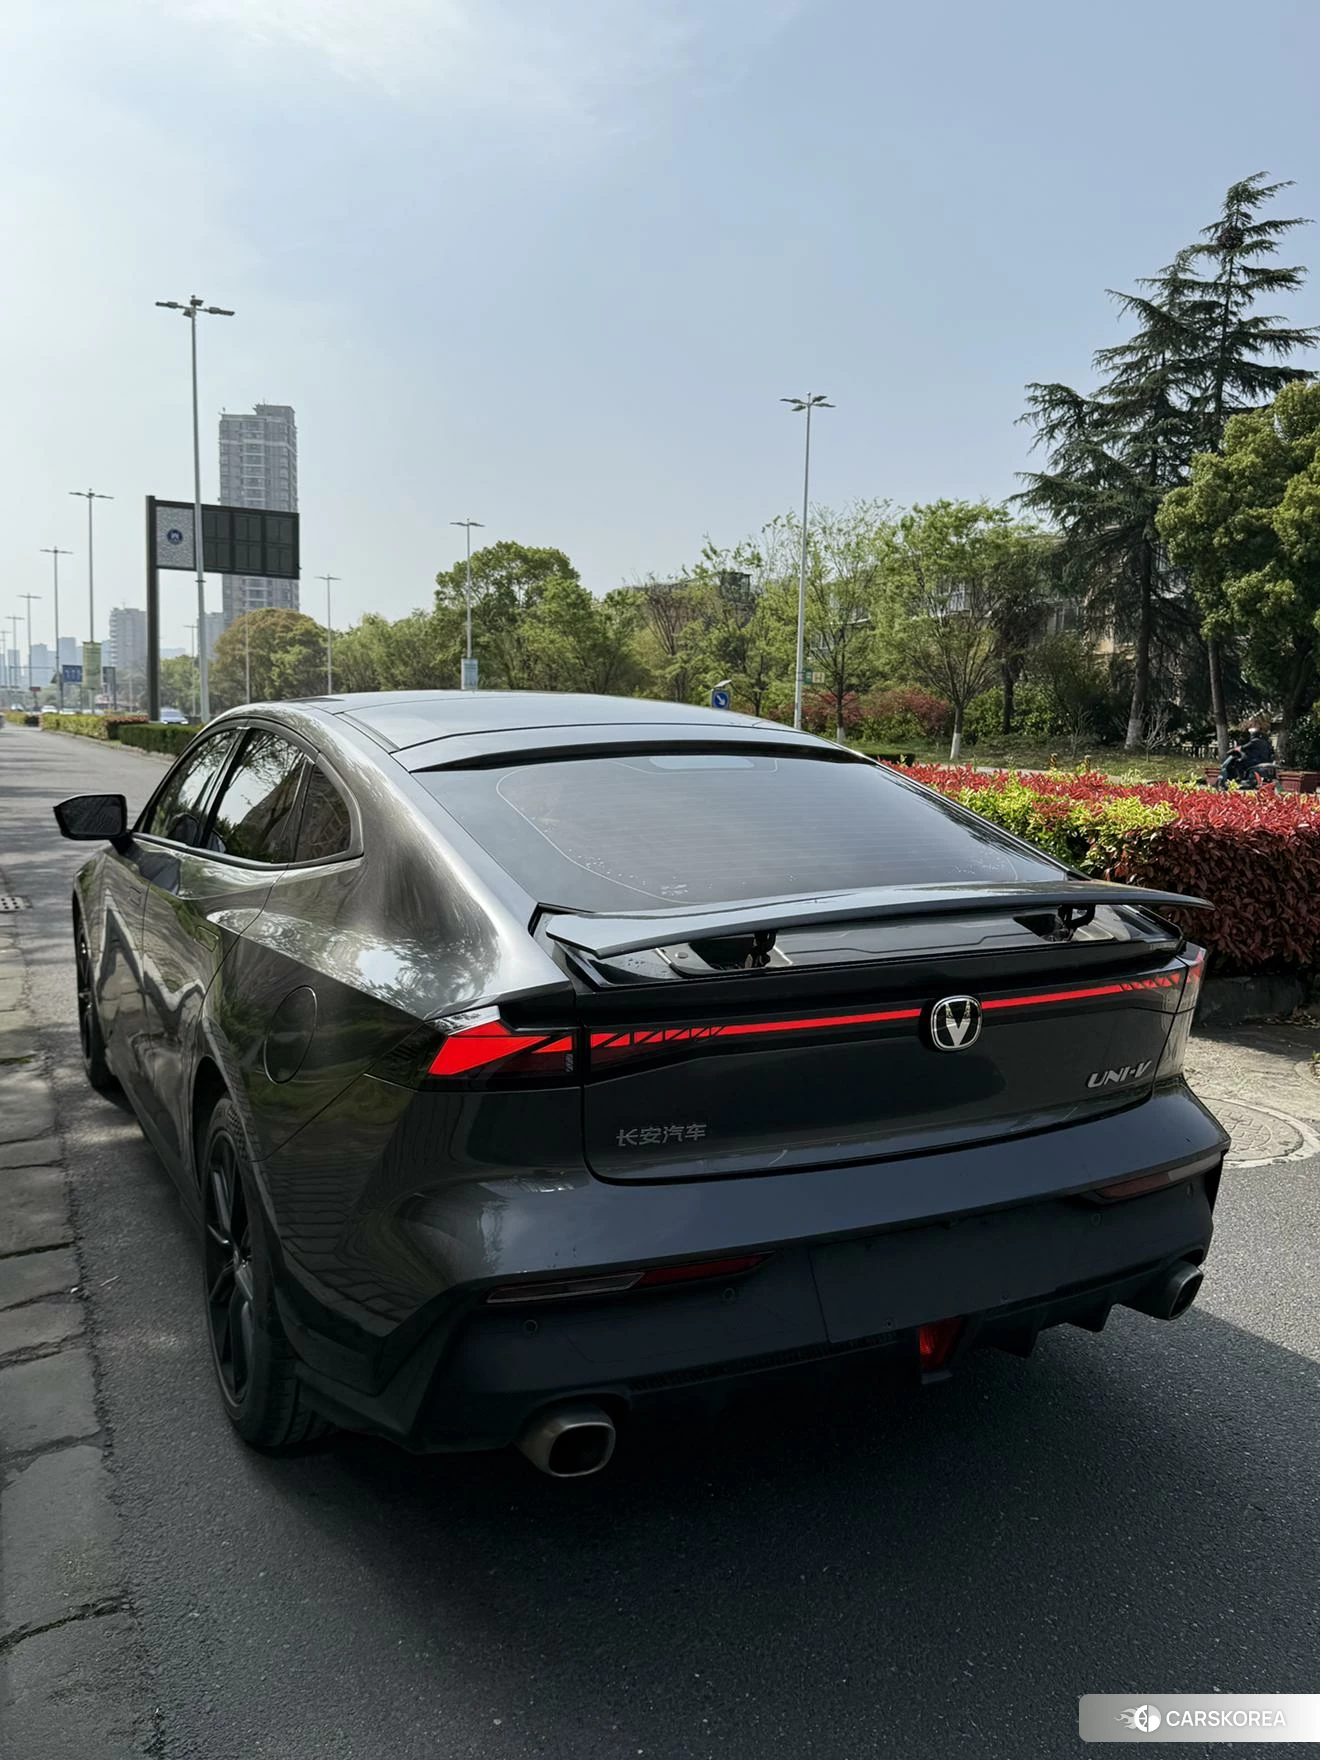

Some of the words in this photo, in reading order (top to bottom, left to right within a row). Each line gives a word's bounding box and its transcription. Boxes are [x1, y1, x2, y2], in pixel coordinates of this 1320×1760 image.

[1087, 1060, 1152, 1088] UNI-V
[616, 1123, 707, 1147] 长安汽车
